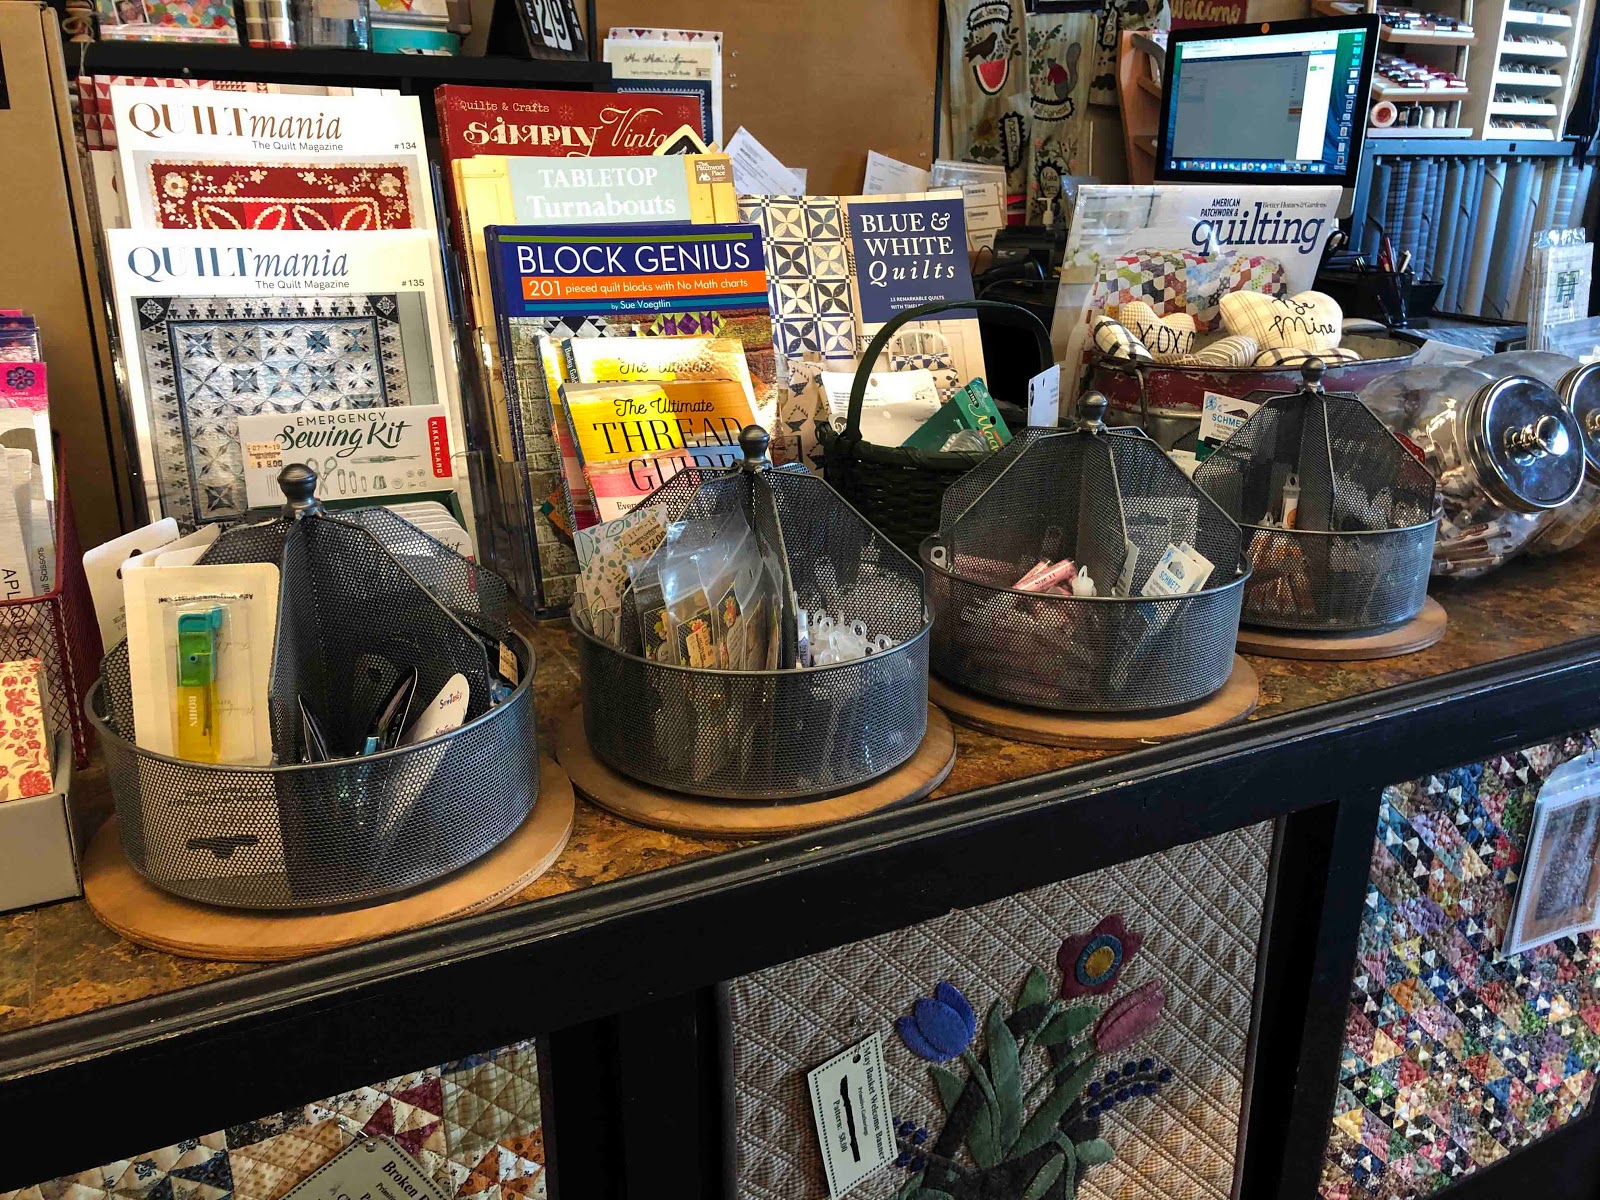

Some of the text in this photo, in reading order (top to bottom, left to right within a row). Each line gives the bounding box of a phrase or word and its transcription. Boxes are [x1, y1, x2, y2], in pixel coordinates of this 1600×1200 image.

[459, 100, 550, 113] Quilts & Crafts
[599, 107, 668, 148] Vinta
[252, 140, 344, 153] The Quilt Magazine
[394, 142, 417, 150] #134
[538, 167, 658, 189] TABLETOP
[526, 193, 676, 219] Turnabouts
[1200, 208, 1239, 218] PATCHWORK &
[1211, 198, 1241, 208] AMERICAN
[860, 212, 926, 233] BLUE
[930, 212, 951, 232] &
[1191, 201, 1326, 257] quilting
[863, 236, 954, 257] WHITE
[517, 242, 750, 274] BLOCK GENIUS
[401, 279, 425, 287] #135
[868, 259, 955, 288] Quilts
[255, 280, 350, 291] The Quilt Magazine
[529, 278, 748, 297] 201 pieced quilt blocks with No Math charts
[611, 299, 671, 310] by Sue Voegtlin
[613, 397, 715, 417] The Ultimate
[296, 411, 387, 427] EMERGENCY
[1211, 413, 1241, 428] SCHME
[274, 420, 412, 458] Sewing Kit
[592, 417, 744, 454] THREAD
[431, 420, 443, 476] KIKKERLAND
[616, 501, 637, 511] Ever
[37, 547, 49, 582] Scissors
[1159, 570, 1181, 593] SCHMETZ
[862, 1045, 885, 1160] May Basket Welcome Banner
[832, 1099, 843, 1131] Pattern:
[381, 1160, 418, 1197] Broken
[375, 1182, 398, 1200] Primiti
